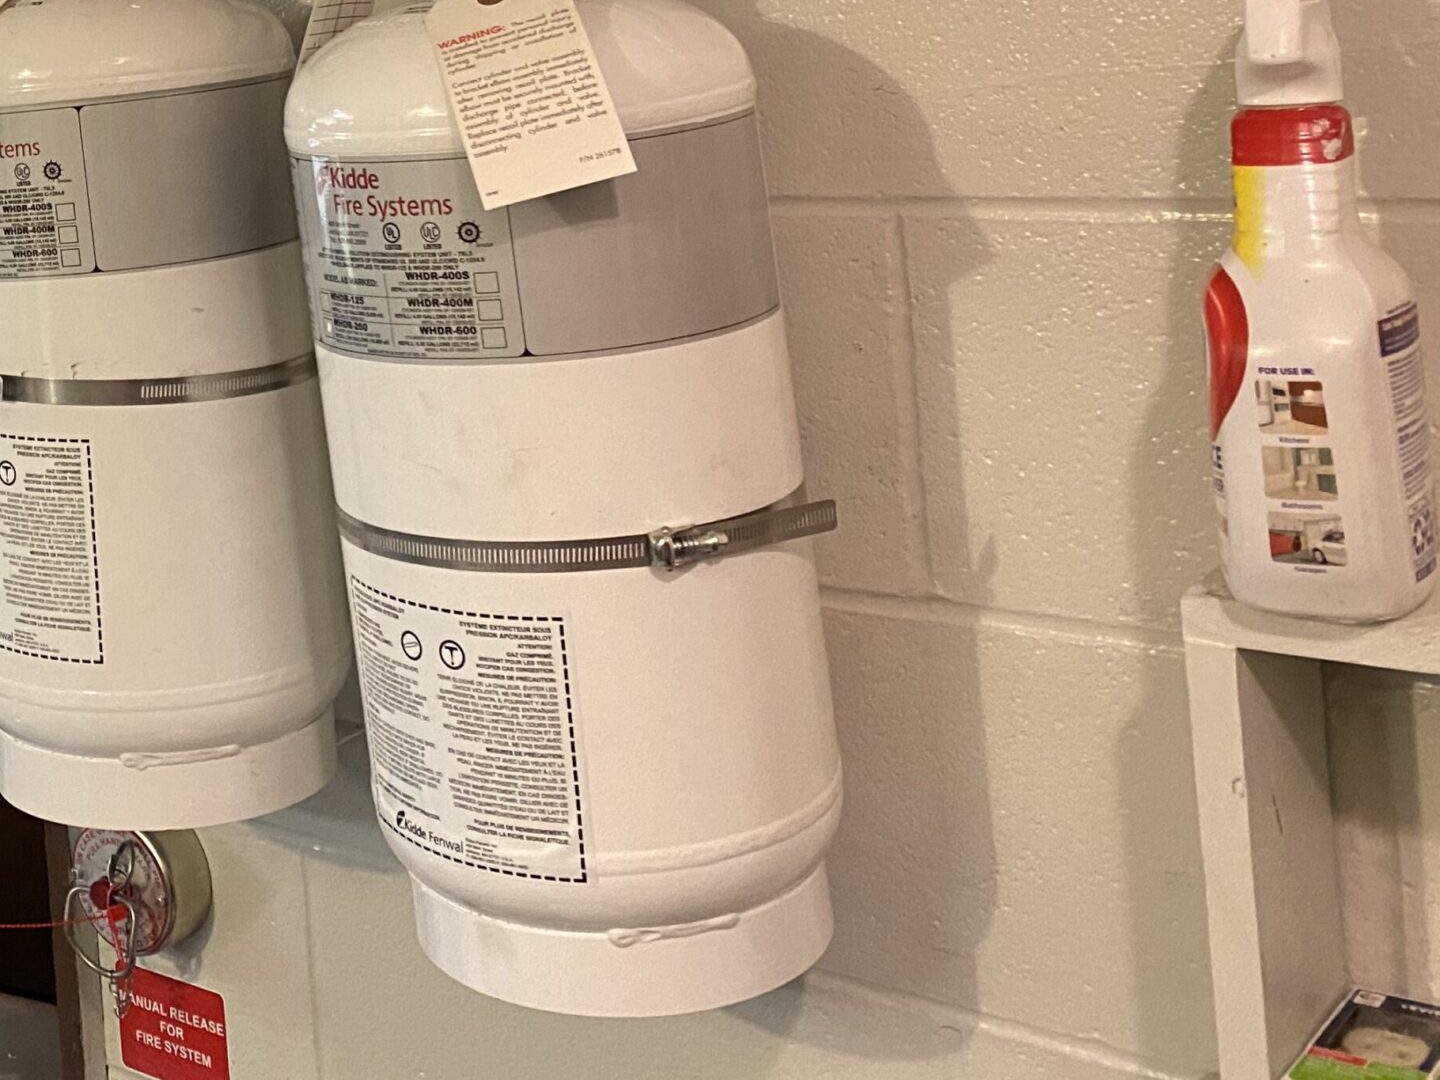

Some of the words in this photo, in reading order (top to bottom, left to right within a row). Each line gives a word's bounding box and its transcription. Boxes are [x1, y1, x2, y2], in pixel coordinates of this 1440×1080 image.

[437, 25, 506, 49] WARNING:
[330, 168, 380, 189] Kidde
[2, 202, 53, 213] WHDR-400S
[333, 194, 363, 217] Fire
[366, 195, 453, 222] Systems
[3, 225, 55, 236] WHDR-400M
[12, 248, 58, 258] WHDR-600
[405, 271, 470, 281] WHDR-400S
[407, 298, 473, 308] WHDR-400M
[419, 325, 477, 335] WHDR-600
[1258, 367, 1278, 376] FOR
[1280, 368, 1299, 376] USE
[404, 820, 427, 840] Kidde
[428, 830, 464, 854] Fenwal
[119, 989, 168, 1017] MANUAL
[170, 1006, 224, 1037] RELEASE
[160, 1020, 184, 1040] FOR
[136, 1030, 162, 1050] FIRE
[164, 1040, 212, 1069] SYSTEM
